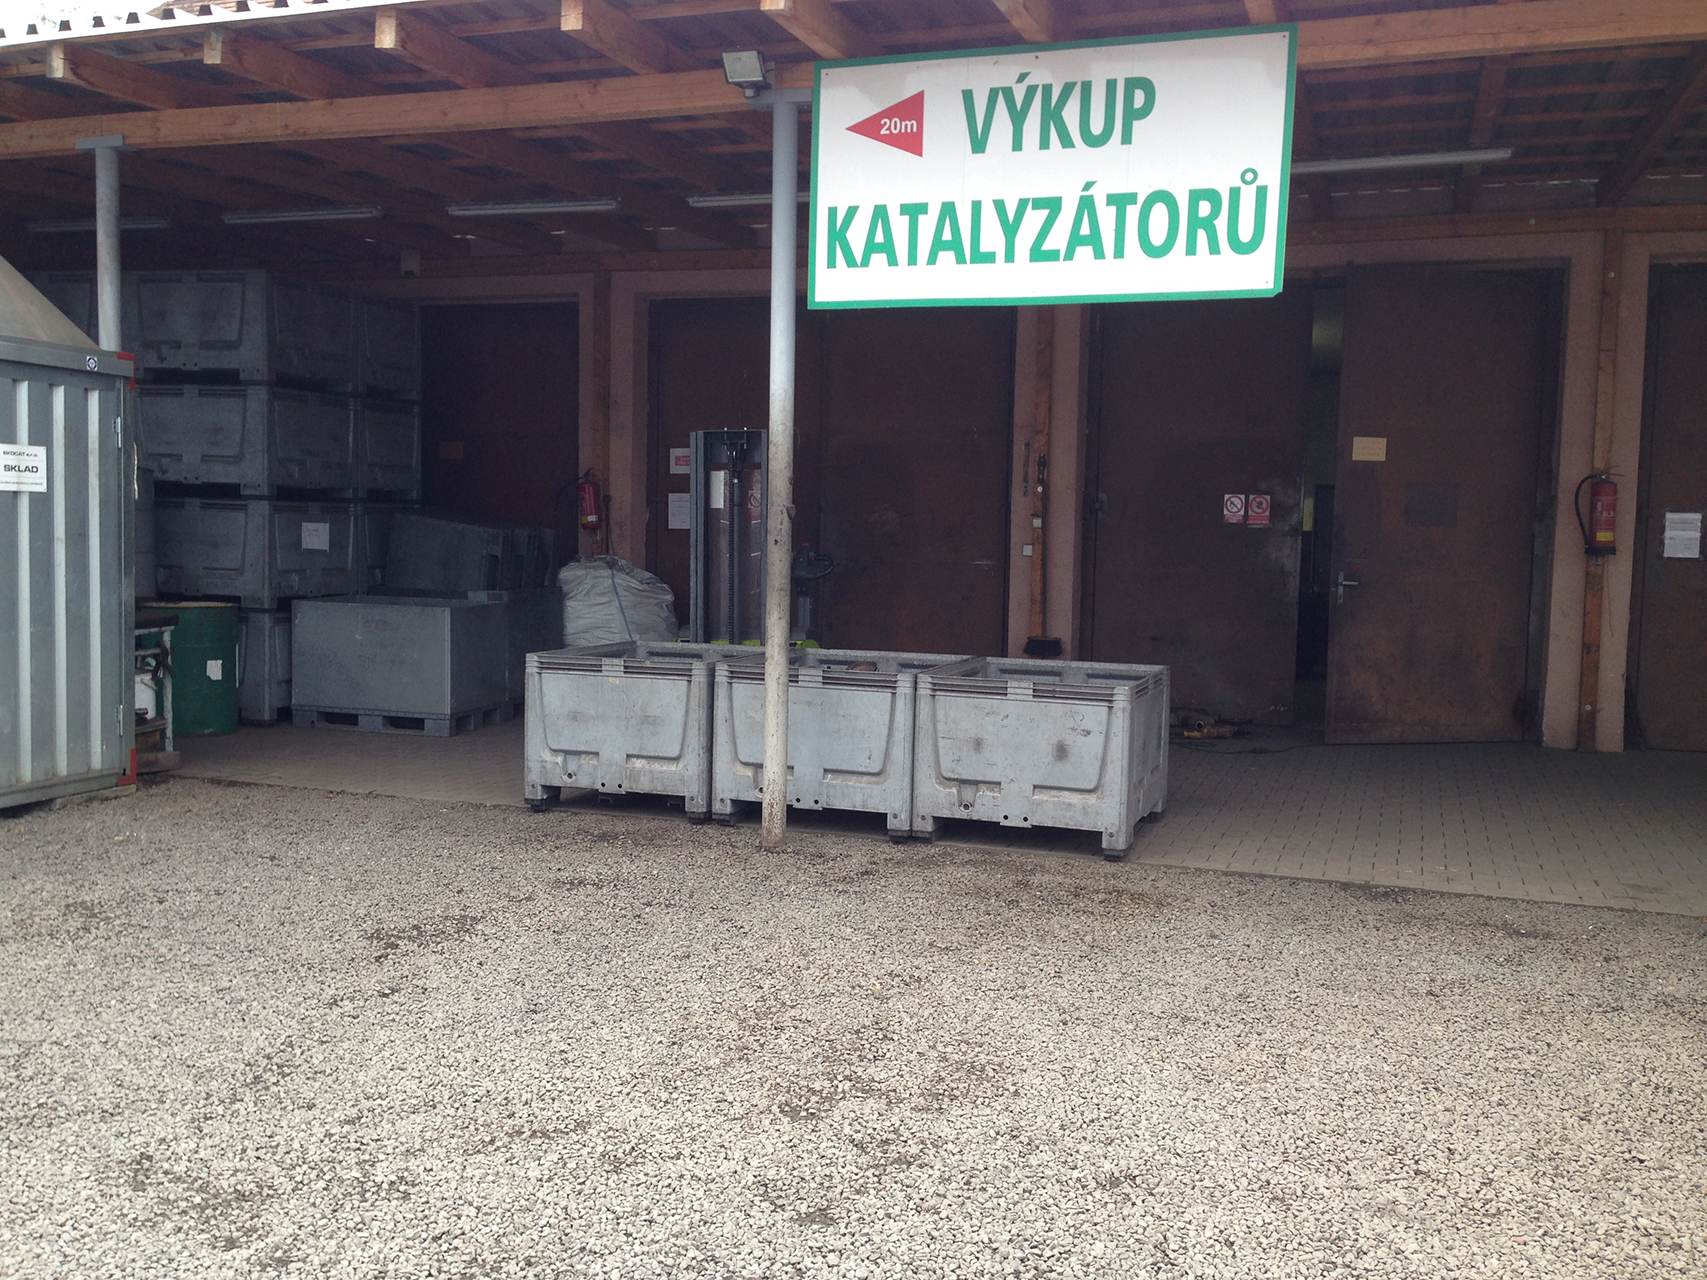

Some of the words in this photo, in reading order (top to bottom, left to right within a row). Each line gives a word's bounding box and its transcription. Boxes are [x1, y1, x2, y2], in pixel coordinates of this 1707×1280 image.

[880, 117, 918, 135] 20m
[961, 71, 1156, 154] VÝKUP
[827, 167, 1269, 269] KATALYZÁTORŮ
[4, 464, 38, 473] SKLAD
